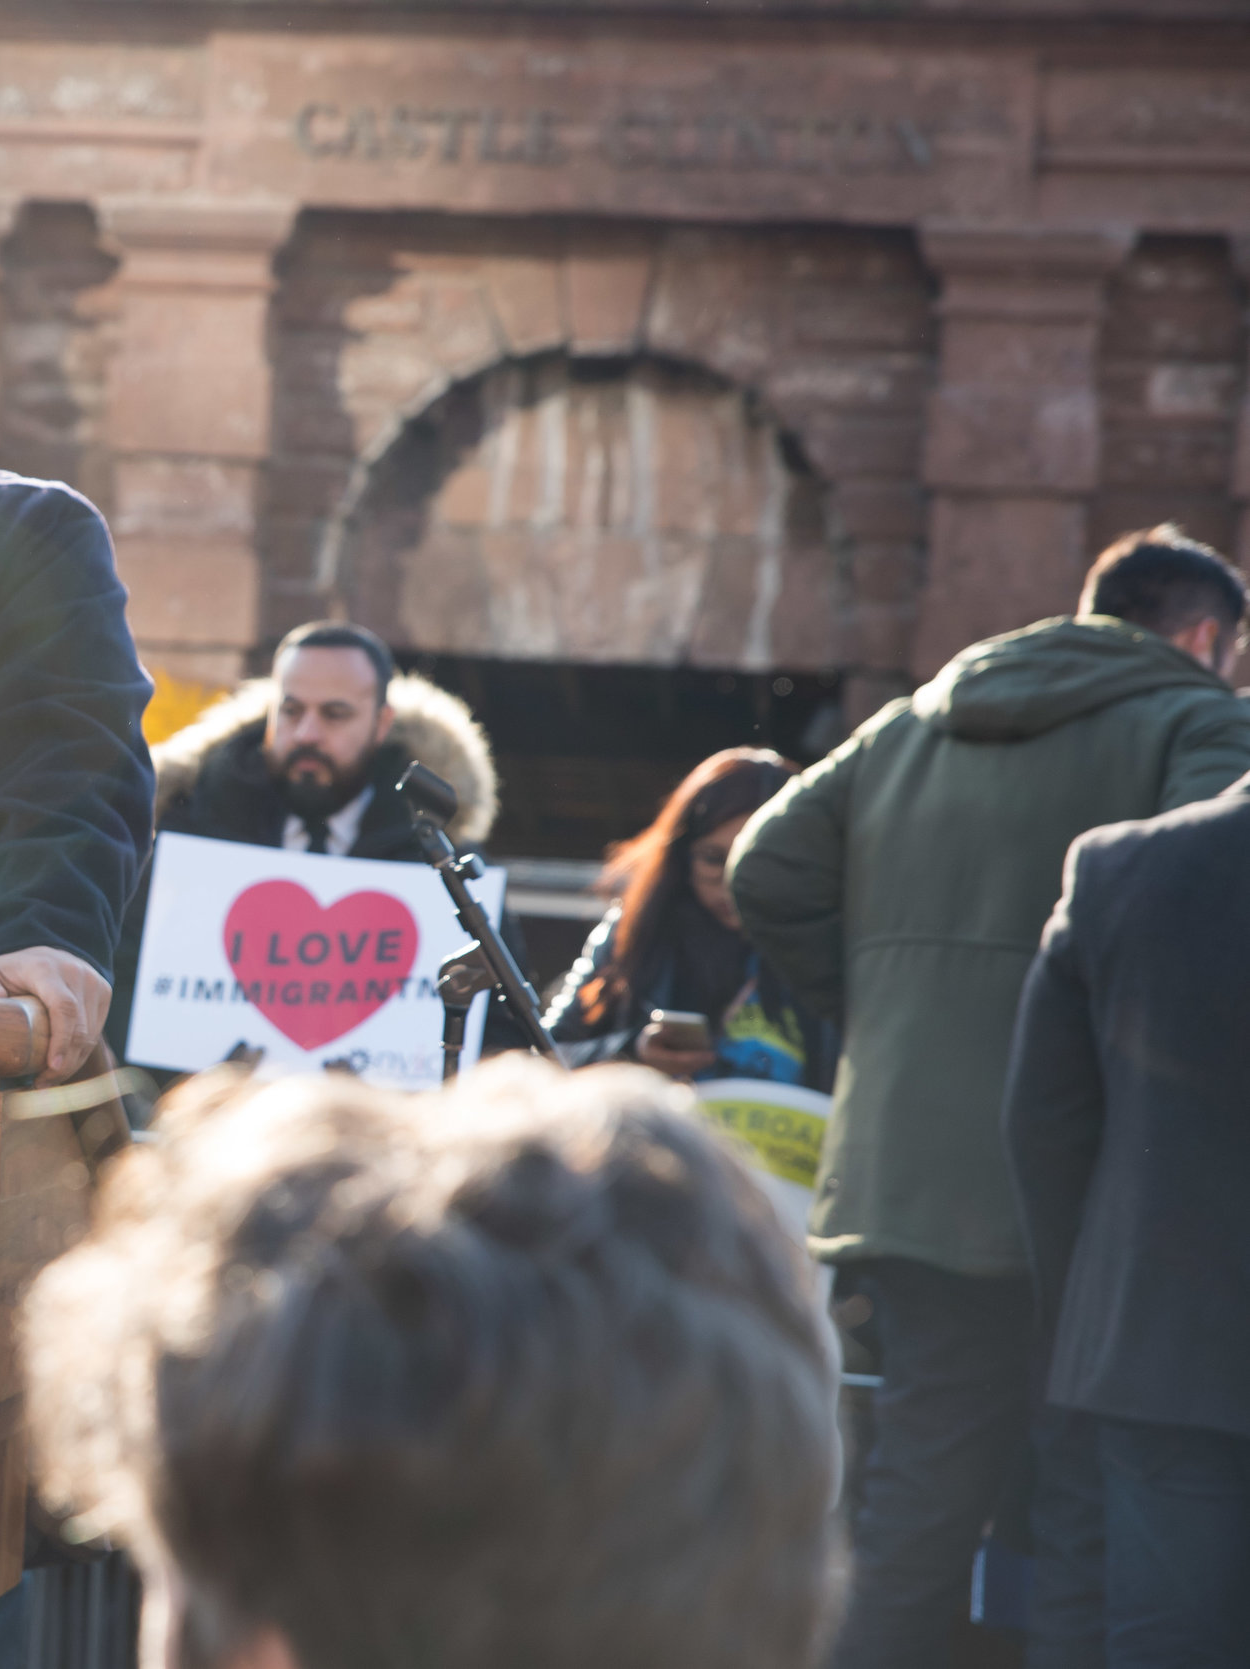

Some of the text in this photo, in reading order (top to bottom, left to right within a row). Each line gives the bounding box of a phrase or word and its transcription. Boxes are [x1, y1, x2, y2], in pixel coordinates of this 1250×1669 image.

[296, 101, 572, 165] CASTLE
[230, 929, 404, 966] I LOVE
[154, 976, 439, 1005] #IMMIGRANTN
